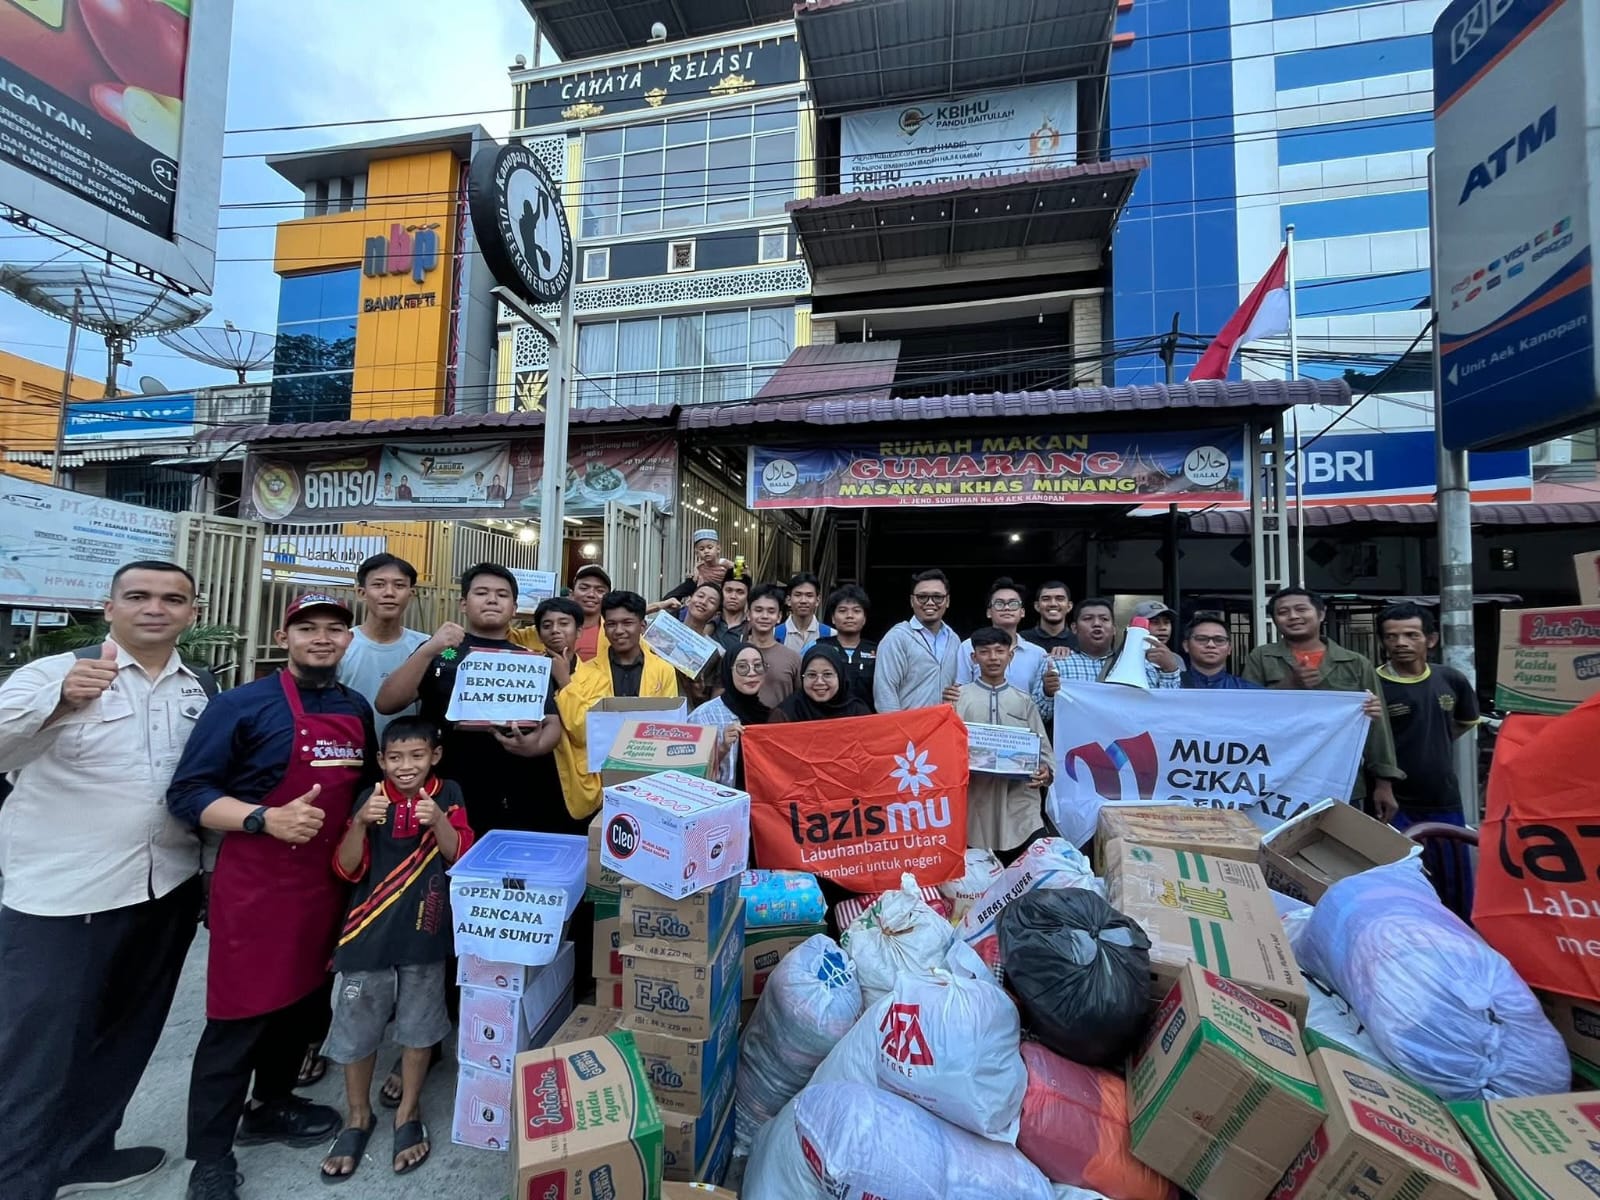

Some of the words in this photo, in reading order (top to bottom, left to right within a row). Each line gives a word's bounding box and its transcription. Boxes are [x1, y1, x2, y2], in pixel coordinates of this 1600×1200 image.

[561, 71, 642, 99] CAHAYA
[668, 52, 753, 83] RELASI
[936, 100, 989, 120] KBIHU
[936, 116, 967, 128] PANDU
[968, 109, 1015, 125] BAITULLAH
[45, 131, 91, 161] KANKER
[1458, 105, 1557, 206] ATM
[1, 132, 27, 152] DAN
[29, 147, 83, 180] MEMBERI
[88, 178, 128, 205] KEPADA
[22, 153, 48, 172] DAN
[50, 168, 116, 207] PEREMPUAN
[495, 151, 527, 188] Kanopan
[853, 170, 901, 185] KBIHU
[499, 209, 518, 252] ULEE
[515, 253, 550, 296] KARENG
[556, 261, 570, 294] GAYO
[1503, 242, 1531, 263] VISA
[364, 295, 403, 313] BANK
[1461, 358, 1487, 376] Unit
[1490, 345, 1515, 365] Aek
[1519, 313, 1588, 352] Kanopan
[880, 439, 972, 456] RUMAH
[982, 434, 1088, 452] MAKAN
[851, 451, 1122, 480] GUMARANG
[1308, 449, 1374, 483] BRI
[304, 470, 376, 509] BAKSO
[838, 482, 952, 496] MASAKAN
[960, 480, 1023, 496] KHAS
[1032, 478, 1136, 493] MINANG
[1025, 494, 1065, 502] KANOPAN
[59, 499, 84, 516] PT.
[88, 504, 138, 525] ASLAB
[307, 547, 337, 560] bank
[460, 661, 493, 672] OPEN
[496, 663, 547, 675] DONASI
[1513, 671, 1558, 685] Ayam
[1514, 659, 1557, 671] Kaldu
[466, 677, 536, 688] BENCANA
[458, 692, 494, 703] ALAM
[497, 693, 543, 704] SUMUT
[1169, 739, 1271, 767] MUDA
[789, 797, 951, 844] lazismu
[612, 825, 634, 850] Cleo
[800, 838, 899, 863] Labuhanbatu
[903, 832, 948, 849] Utara
[867, 857, 901, 872] untuk
[904, 852, 942, 869] negeri
[460, 886, 500, 901] OPEN
[502, 890, 564, 907] DONASI
[977, 899, 1003, 924] BERAS
[1011, 871, 1033, 898] SUPER
[470, 906, 543, 925] BENCANA
[633, 909, 690, 938] E-Ria
[457, 922, 496, 939] ALAM
[499, 928, 553, 944] SUMUT
[634, 979, 690, 1013] E-Ria
[576, 1100, 588, 1131] Rasa
[586, 1090, 605, 1127] Kaldu
[603, 1086, 620, 1124] Ayam
[574, 1169, 583, 1195] BKS
